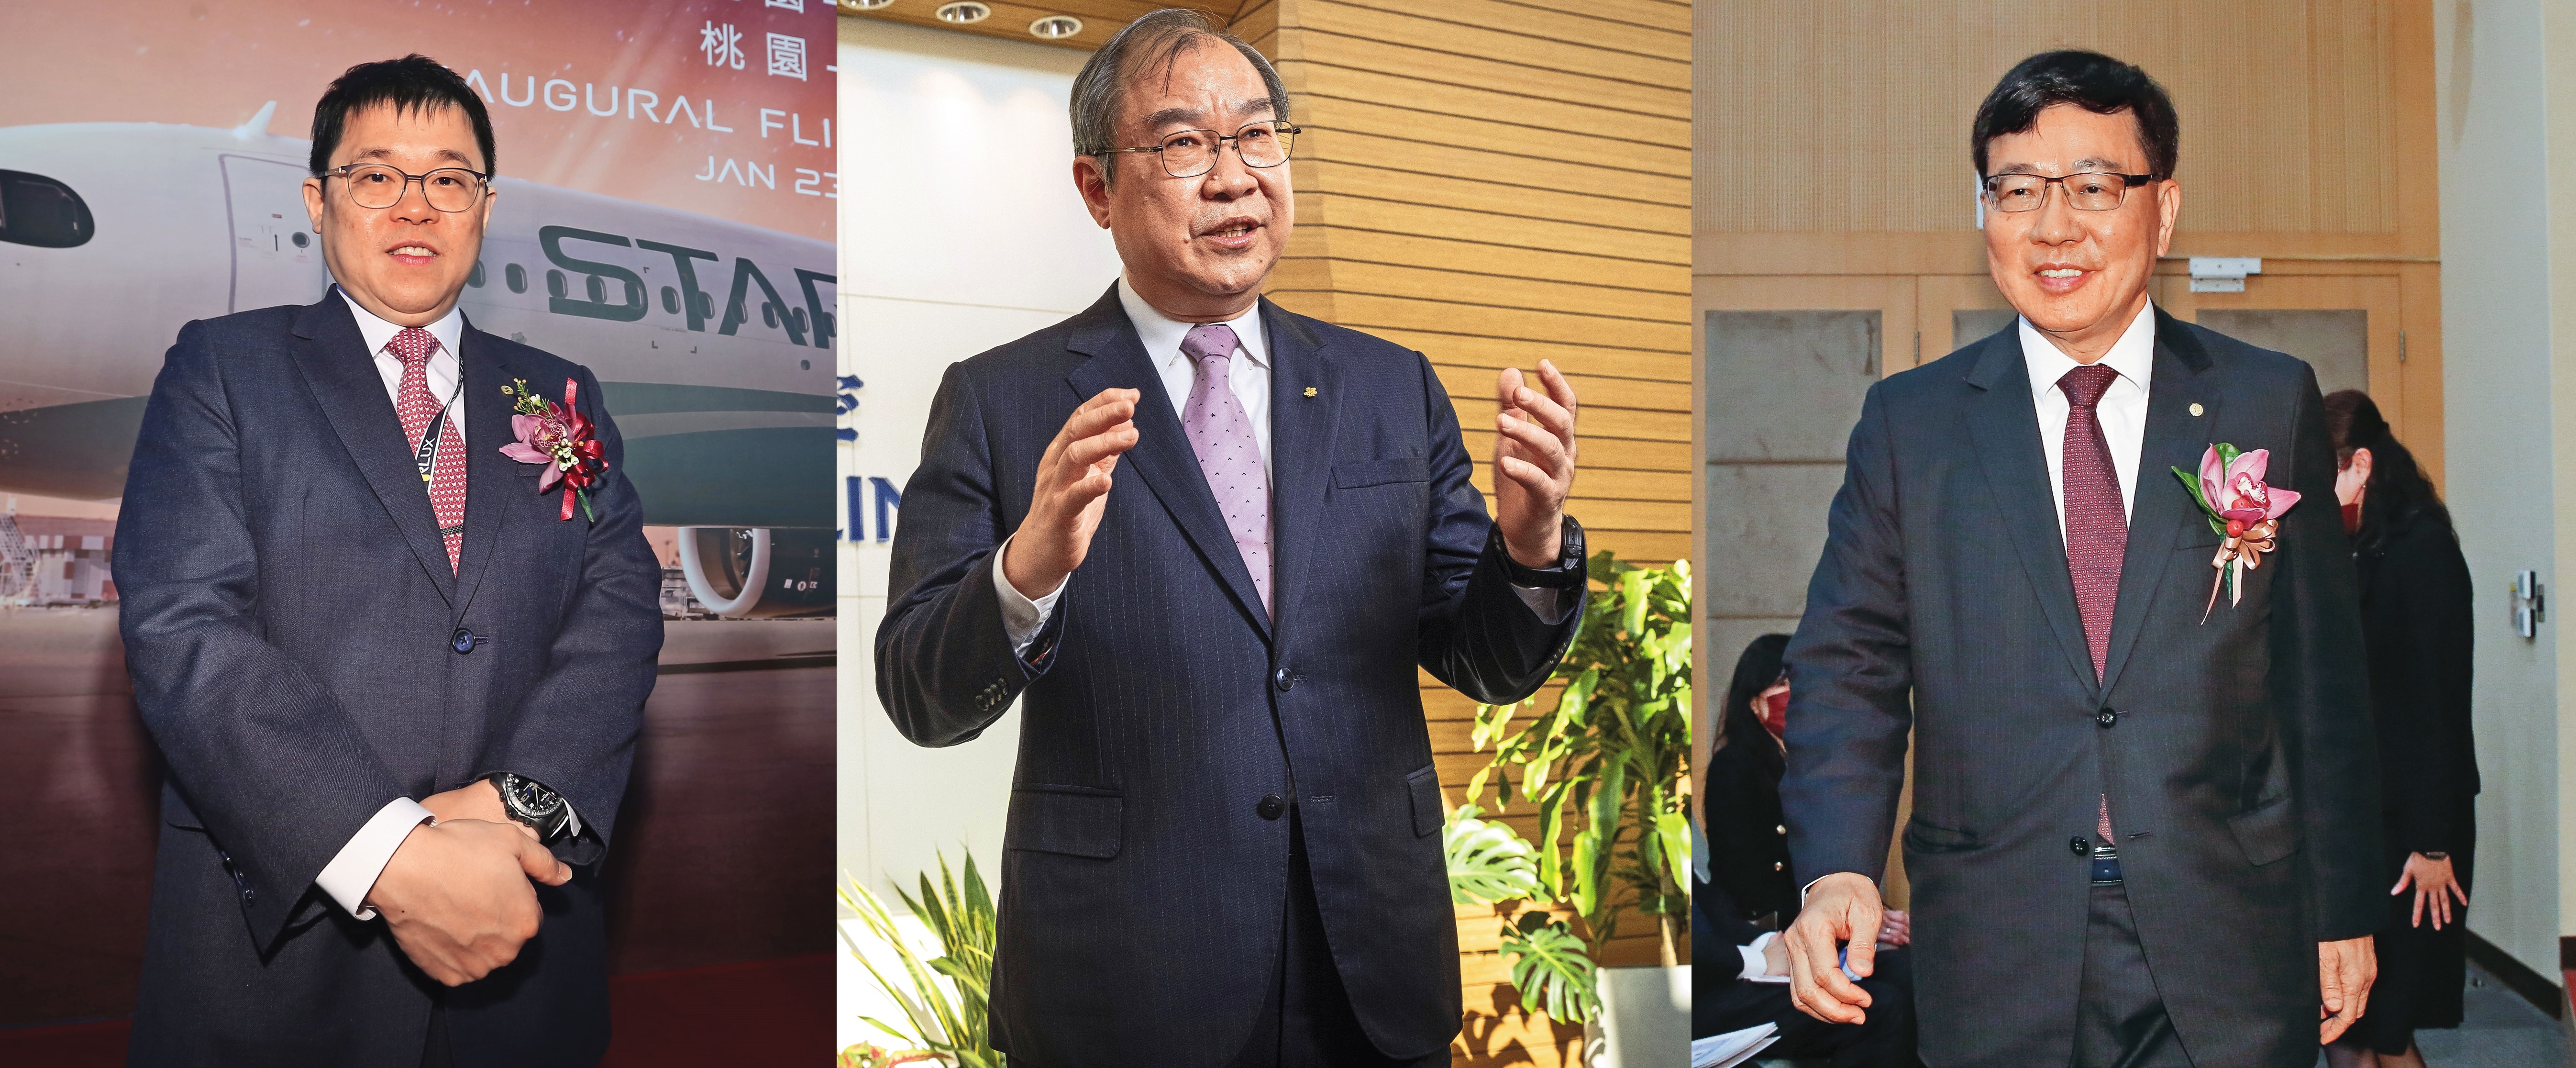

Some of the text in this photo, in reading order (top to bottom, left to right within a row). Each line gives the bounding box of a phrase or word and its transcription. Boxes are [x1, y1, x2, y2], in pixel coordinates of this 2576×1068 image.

[700, 20, 807, 81] 桃園
[442, 65, 831, 148] AUGURAL FLI
[695, 156, 775, 189] JAN
